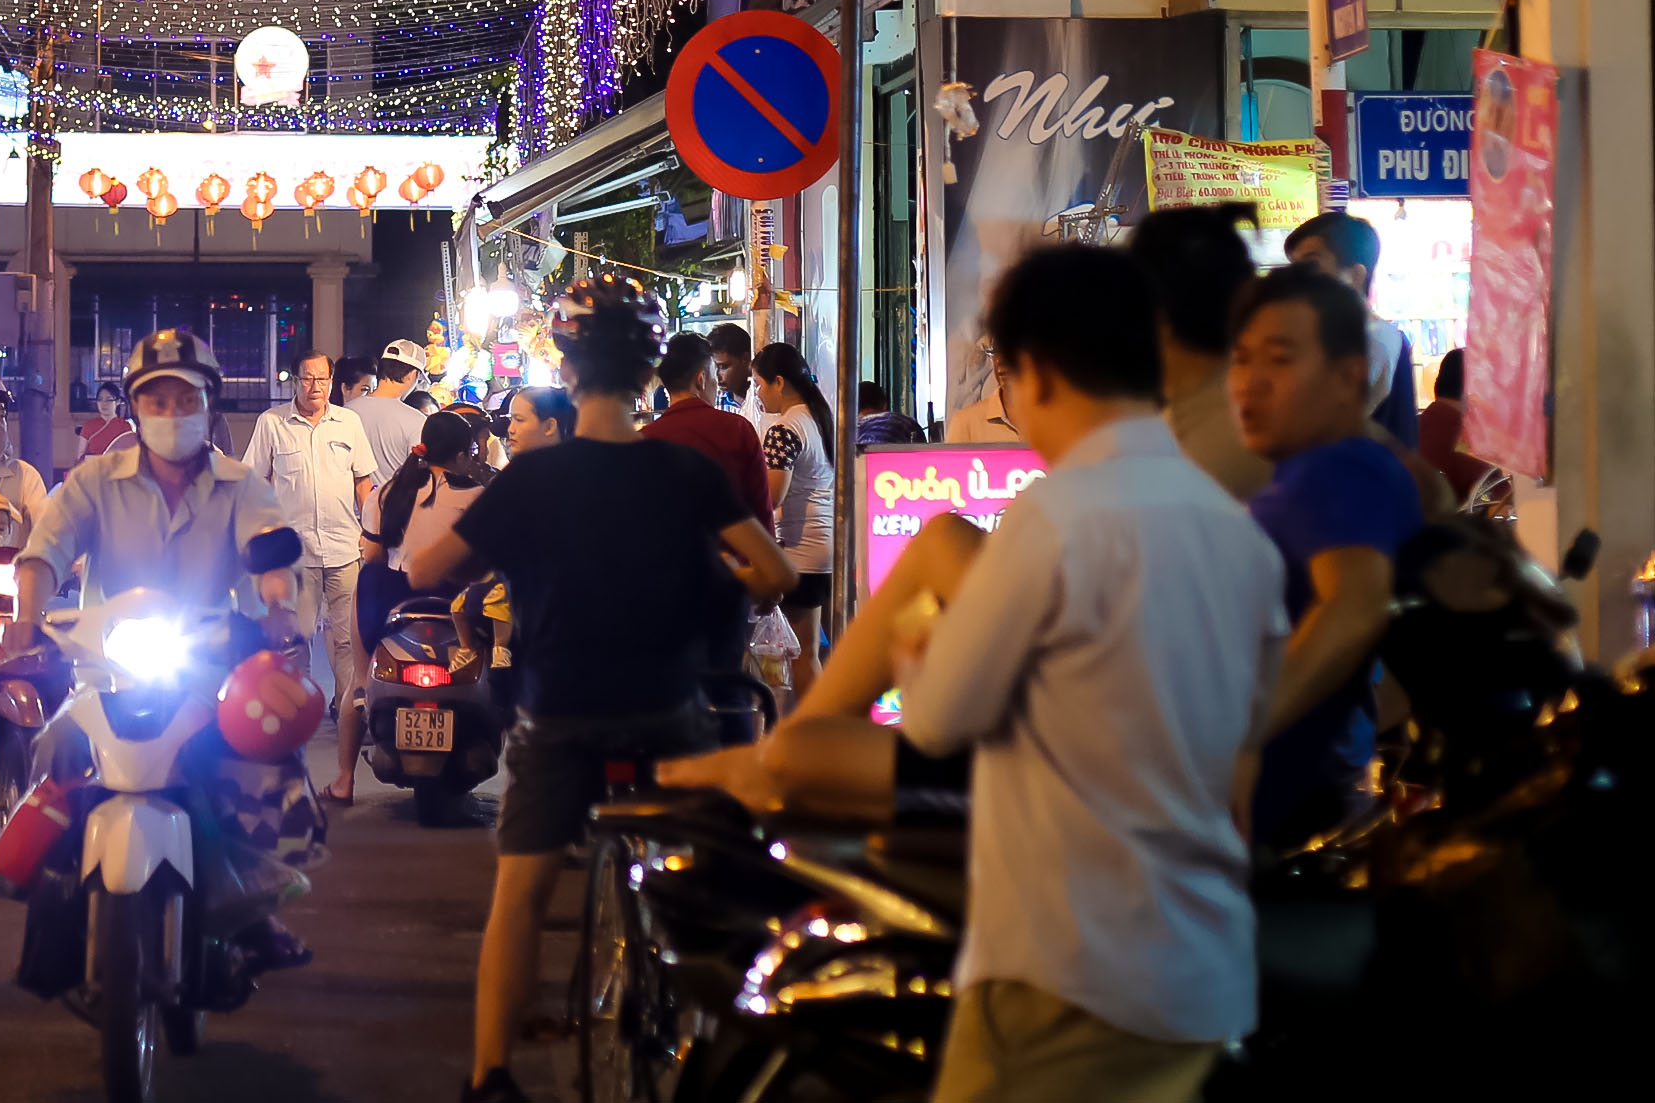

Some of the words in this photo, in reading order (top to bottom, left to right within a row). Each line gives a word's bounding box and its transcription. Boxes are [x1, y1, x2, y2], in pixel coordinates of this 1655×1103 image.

[1378, 141, 1430, 181] PHÚ
[1442, 149, 1472, 180] ĐI
[874, 466, 967, 509] Quán
[872, 514, 922, 537] KEM
[405, 730, 444, 747] 9528
